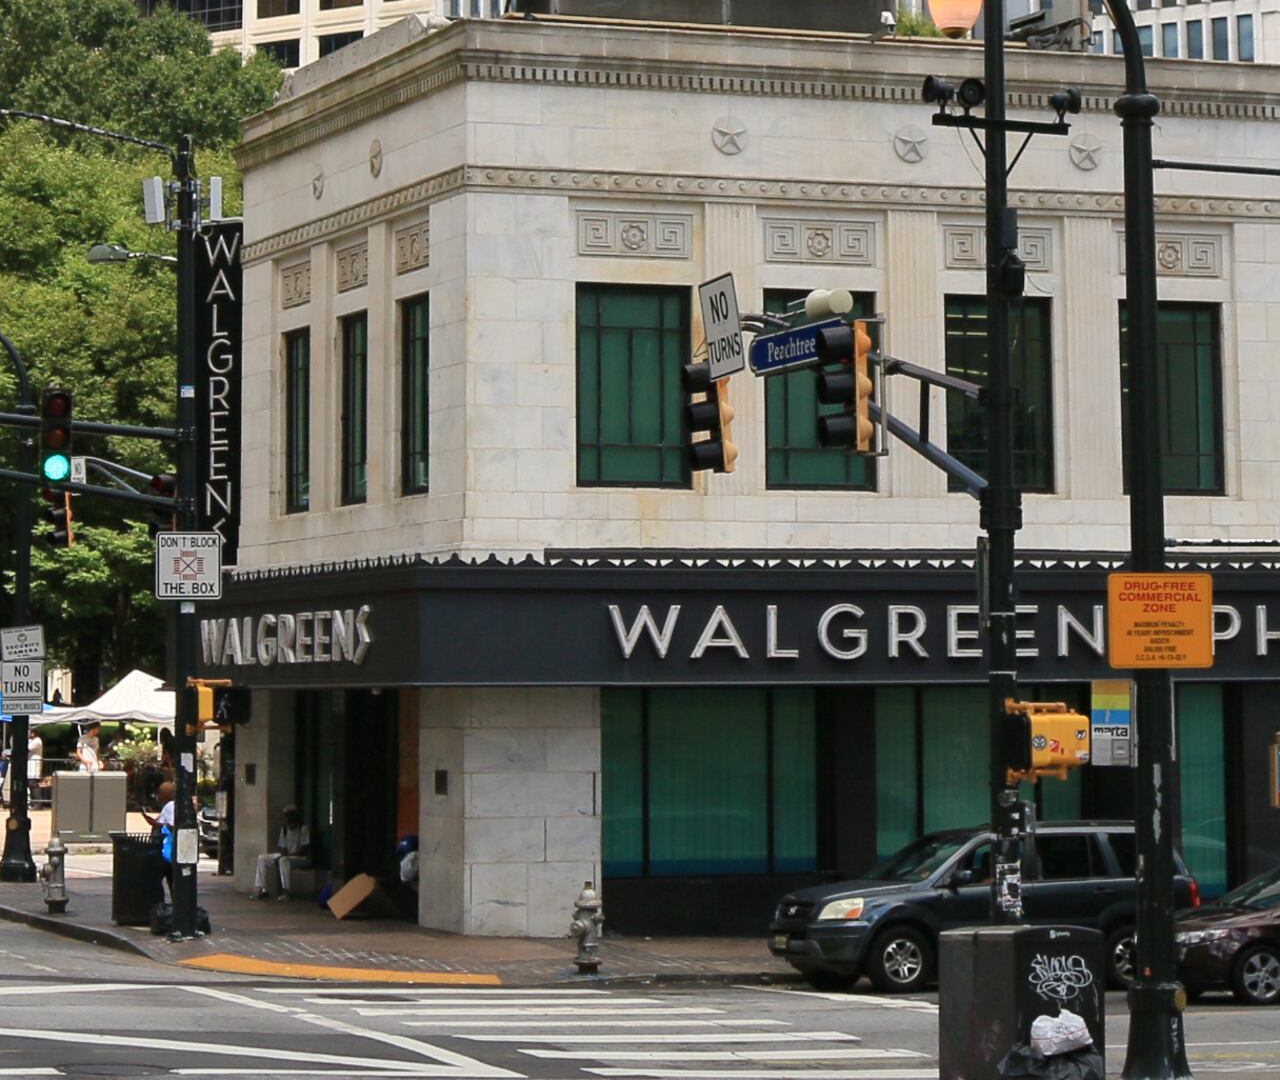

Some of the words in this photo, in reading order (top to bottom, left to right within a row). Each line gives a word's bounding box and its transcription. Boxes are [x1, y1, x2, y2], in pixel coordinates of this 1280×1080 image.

[709, 290, 729, 324] NO
[708, 333, 741, 366] TURNS
[767, 336, 817, 363] Peachtree
[160, 536, 187, 548] DON'T
[190, 536, 218, 548] BLOCK
[163, 582, 186, 594] THE
[191, 582, 216, 594] BOX
[1123, 581, 1196, 591] DRUG-FREE
[1118, 592, 1202, 602] COMMERCIAL
[1142, 603, 1177, 613] ZONE
[200, 604, 372, 666] WALGREENS
[607, 603, 1106, 660] WALGREEN
[5, 642, 40, 651] SECURITY
[7, 648, 39, 656] CAMERA
[14, 664, 30, 678] NO
[3, 680, 41, 694] TURNS
